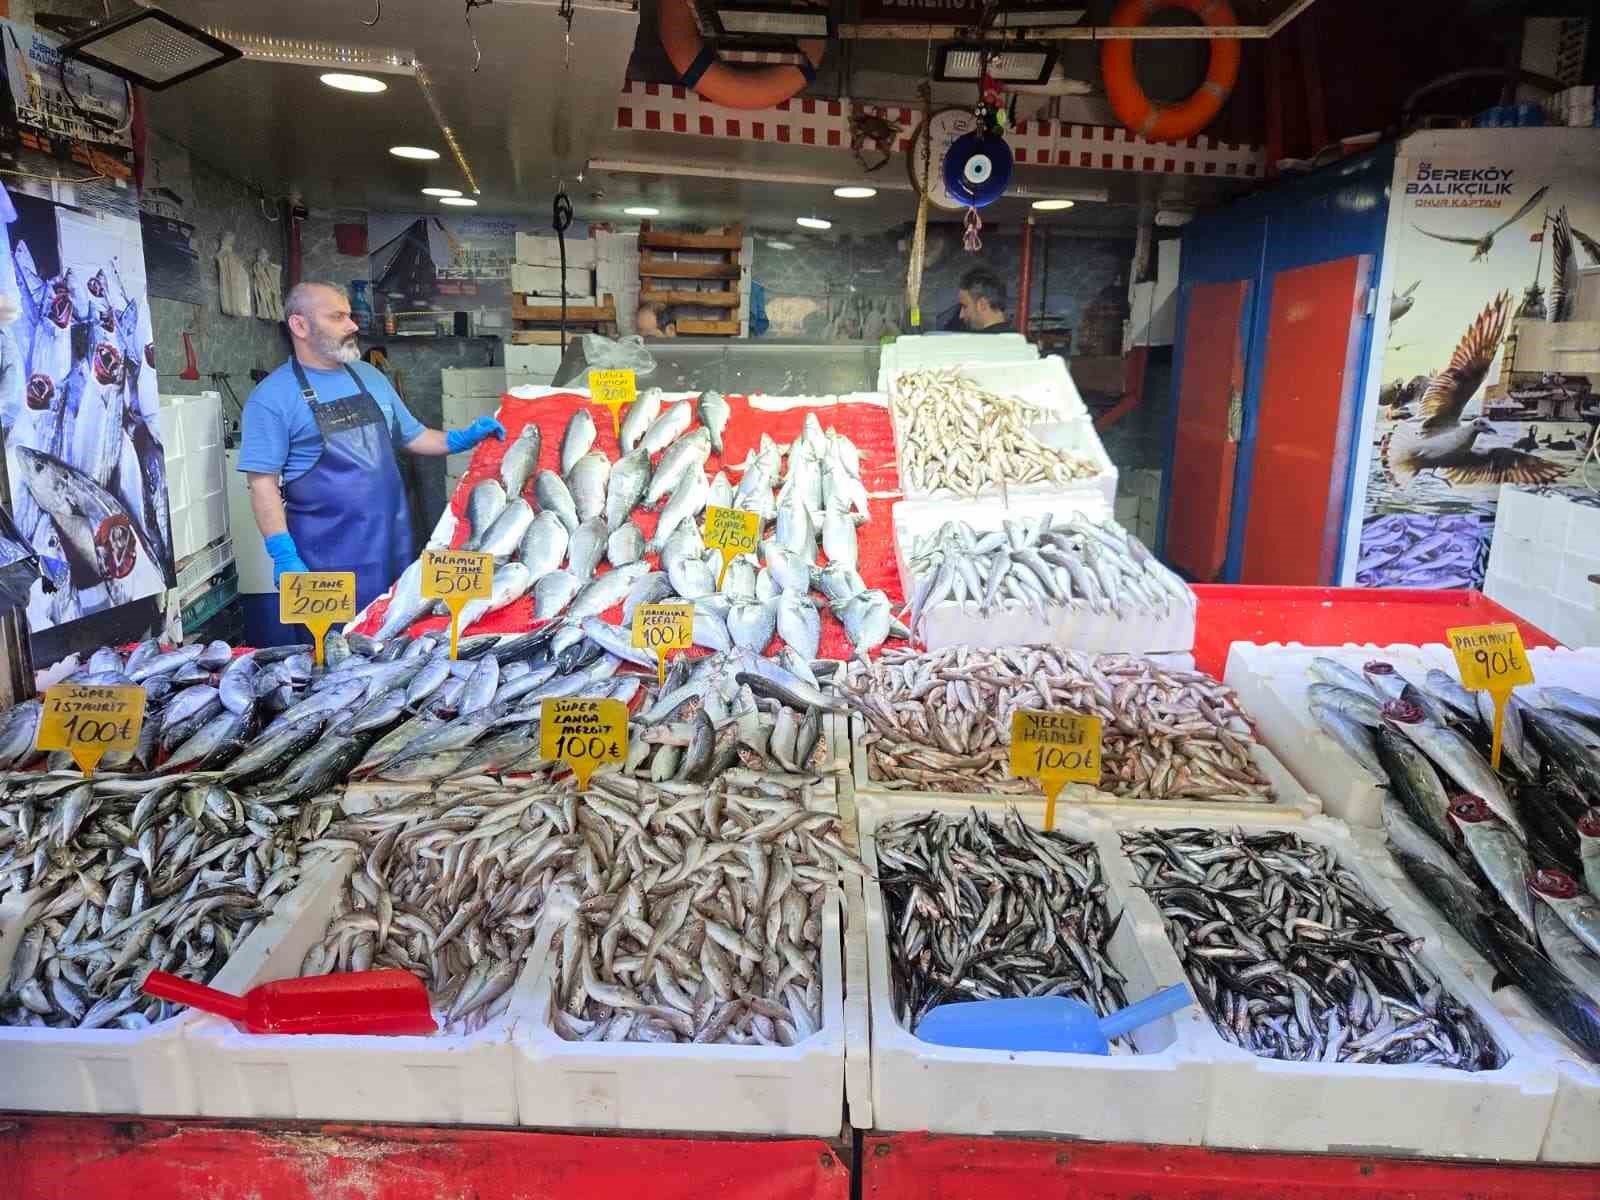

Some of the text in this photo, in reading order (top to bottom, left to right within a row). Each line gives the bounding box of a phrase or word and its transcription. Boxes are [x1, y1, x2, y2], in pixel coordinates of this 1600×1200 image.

[1417, 166, 1514, 181] DEREKÖY
[1405, 183, 1513, 197] BALIKÇILIK
[429, 552, 487, 566] PALAMUT
[289, 576, 344, 598] 4 TANE
[68, 687, 117, 699] SÜPER
[553, 700, 600, 712] SÜPER
